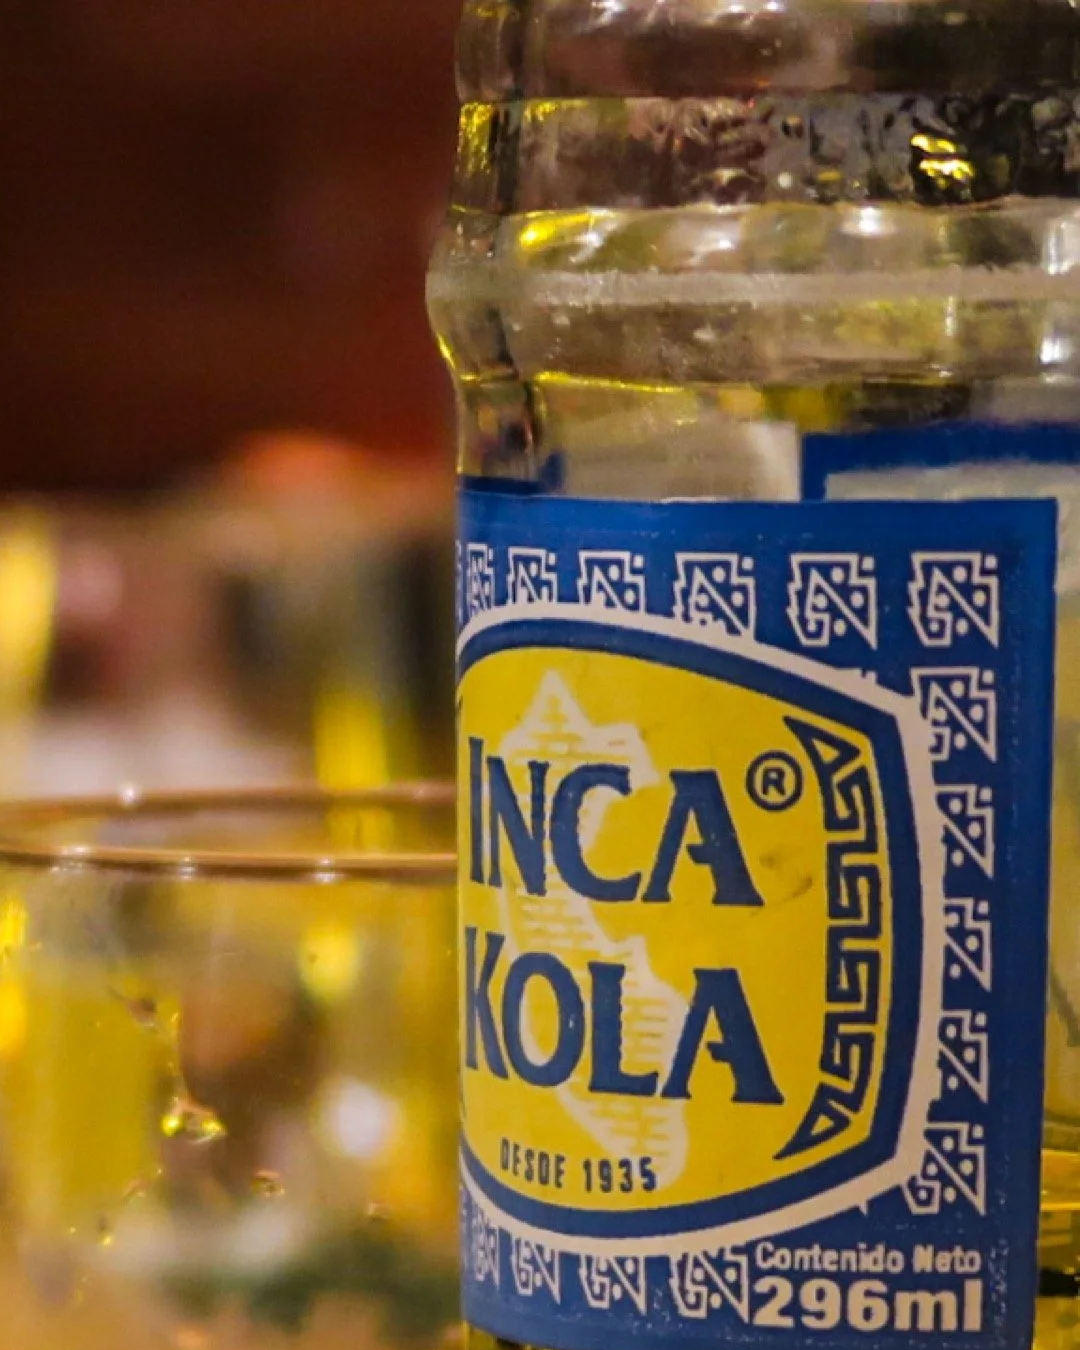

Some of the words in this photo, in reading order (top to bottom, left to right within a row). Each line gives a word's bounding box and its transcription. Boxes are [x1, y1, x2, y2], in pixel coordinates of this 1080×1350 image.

[468, 737, 765, 907] INCA
[465, 926, 785, 1106] KOLA
[500, 1137, 566, 1189] DESDE
[583, 1156, 657, 1193] 1935
[755, 1241, 905, 1273] Contenido
[912, 1243, 982, 1274] Neto
[752, 1275, 983, 1332] 296ml
